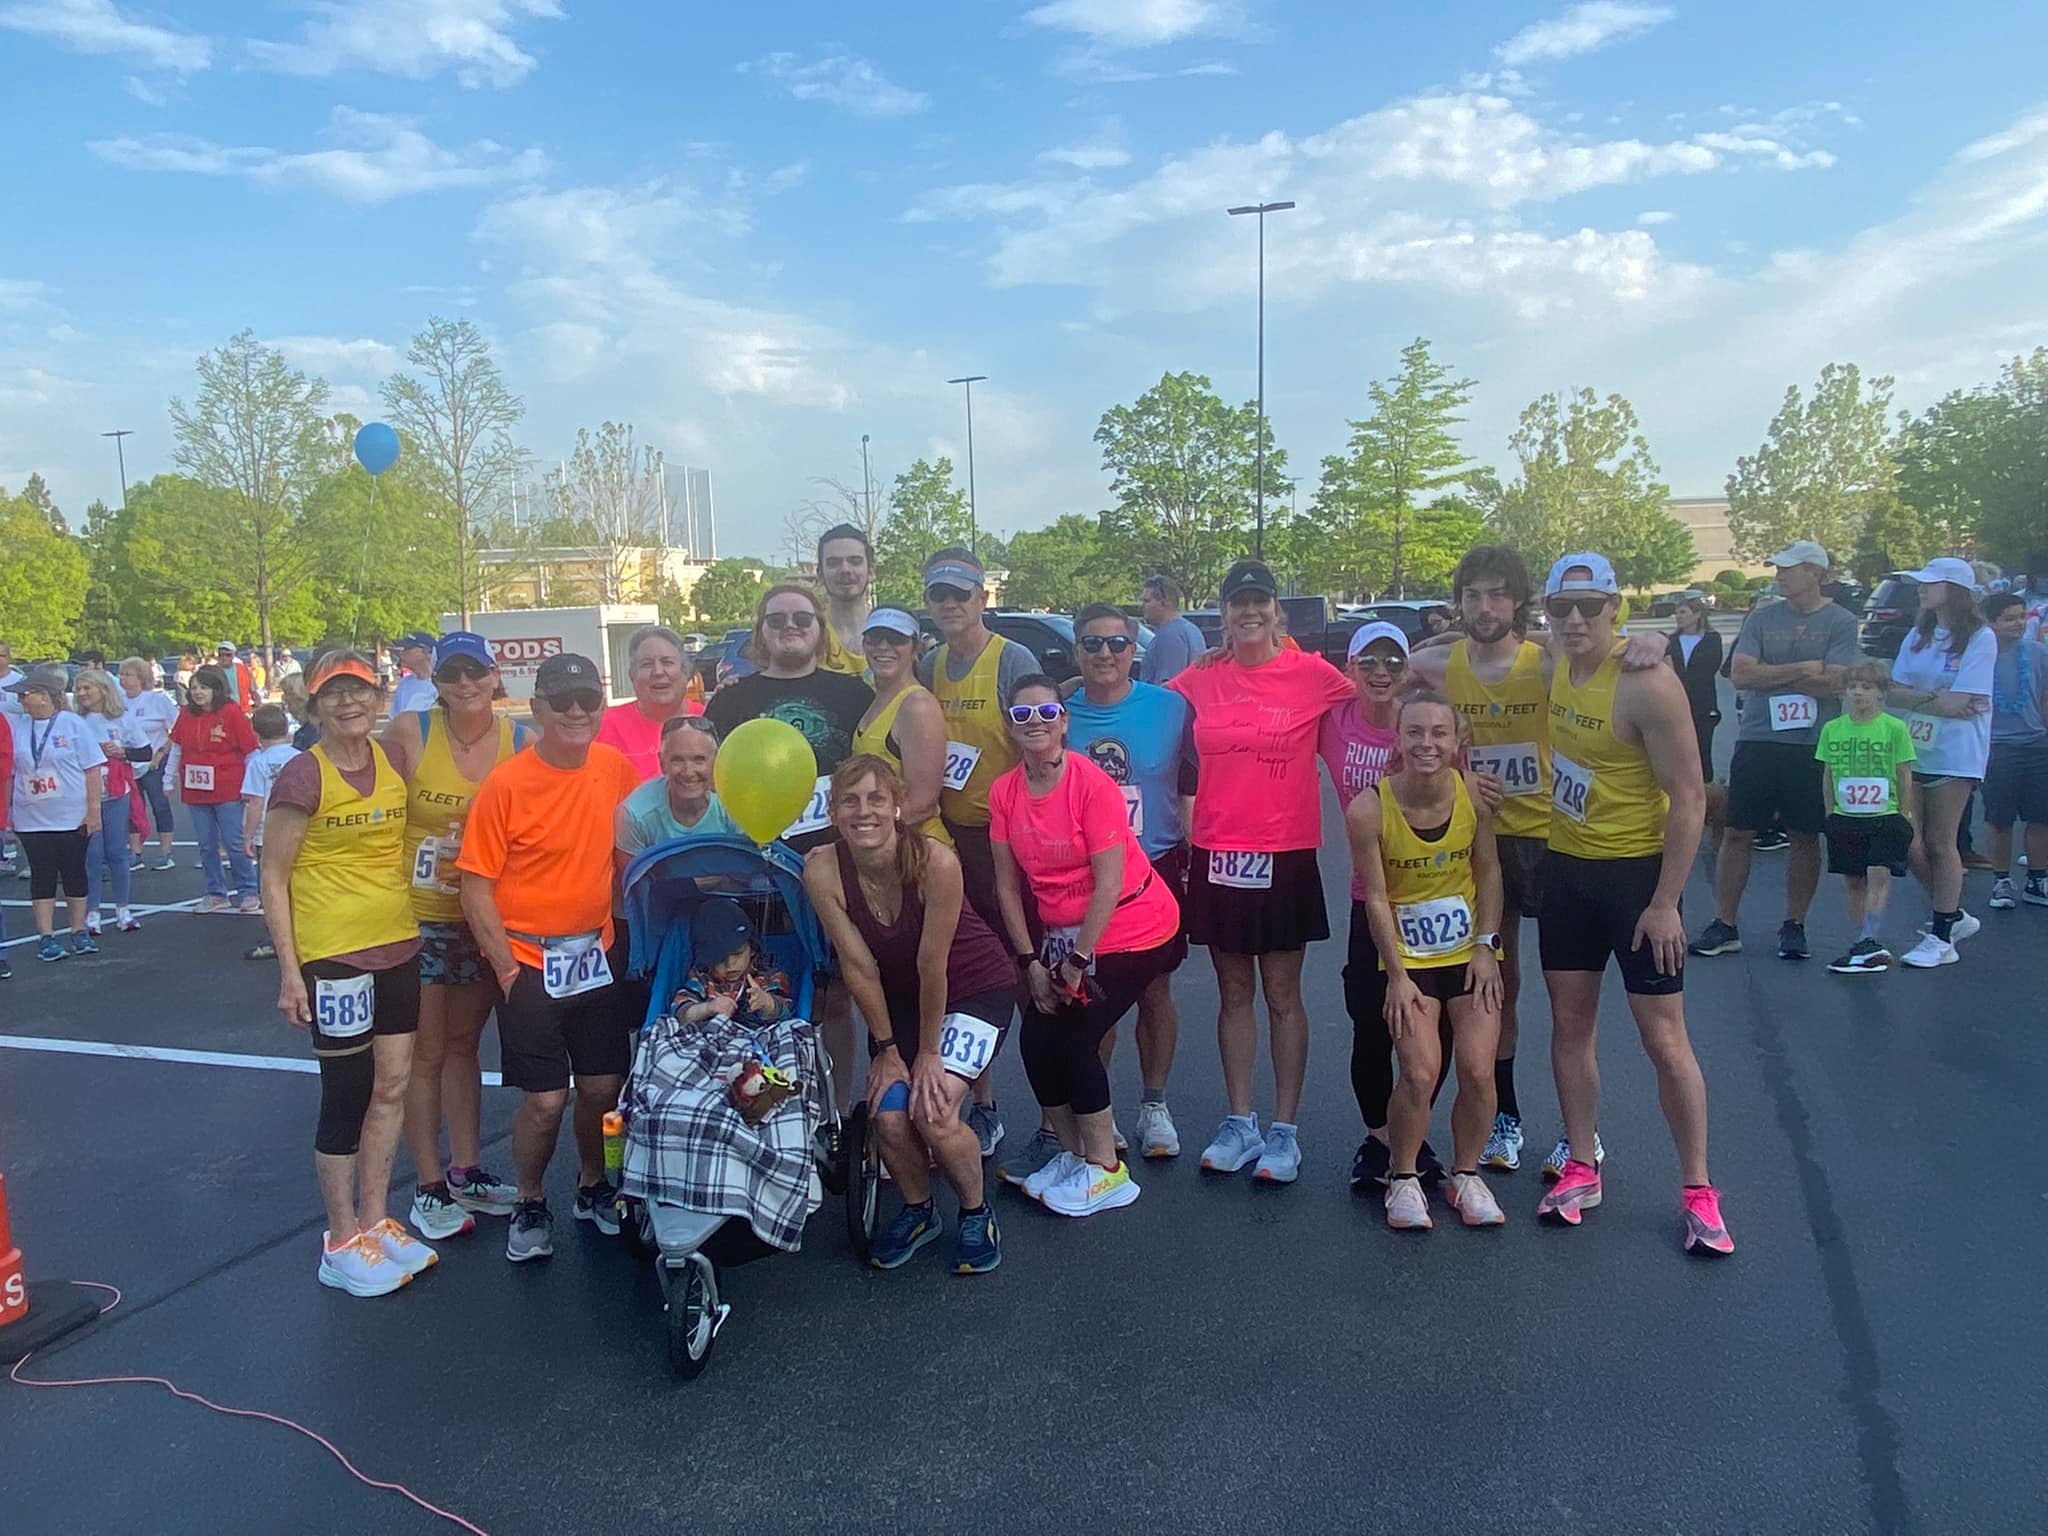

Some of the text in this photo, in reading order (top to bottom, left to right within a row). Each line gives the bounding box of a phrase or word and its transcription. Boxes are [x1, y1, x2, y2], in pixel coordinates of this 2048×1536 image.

[960, 699, 987, 710] FEET
[1454, 703, 1539, 715] LEET FEET
[1778, 702, 1811, 722] 321
[1576, 714, 1606, 732] FEET
[189, 769, 211, 785] 353
[944, 754, 974, 782] 28
[1342, 766, 1384, 789] CHAN
[29, 777, 57, 796] 364
[1552, 766, 1587, 813] 728
[1845, 785, 1882, 805] 322
[416, 789, 465, 807] FLEET
[326, 813, 370, 829] FLEET
[1126, 800, 1139, 827] 7
[416, 850, 435, 879] 5
[1212, 850, 1271, 880] 5822
[1388, 848, 1470, 870] FLEET FE
[1401, 909, 1470, 947] 5823
[546, 947, 608, 988] 5762
[941, 1026, 988, 1070] 831
[4, 1272, 25, 1307] S
